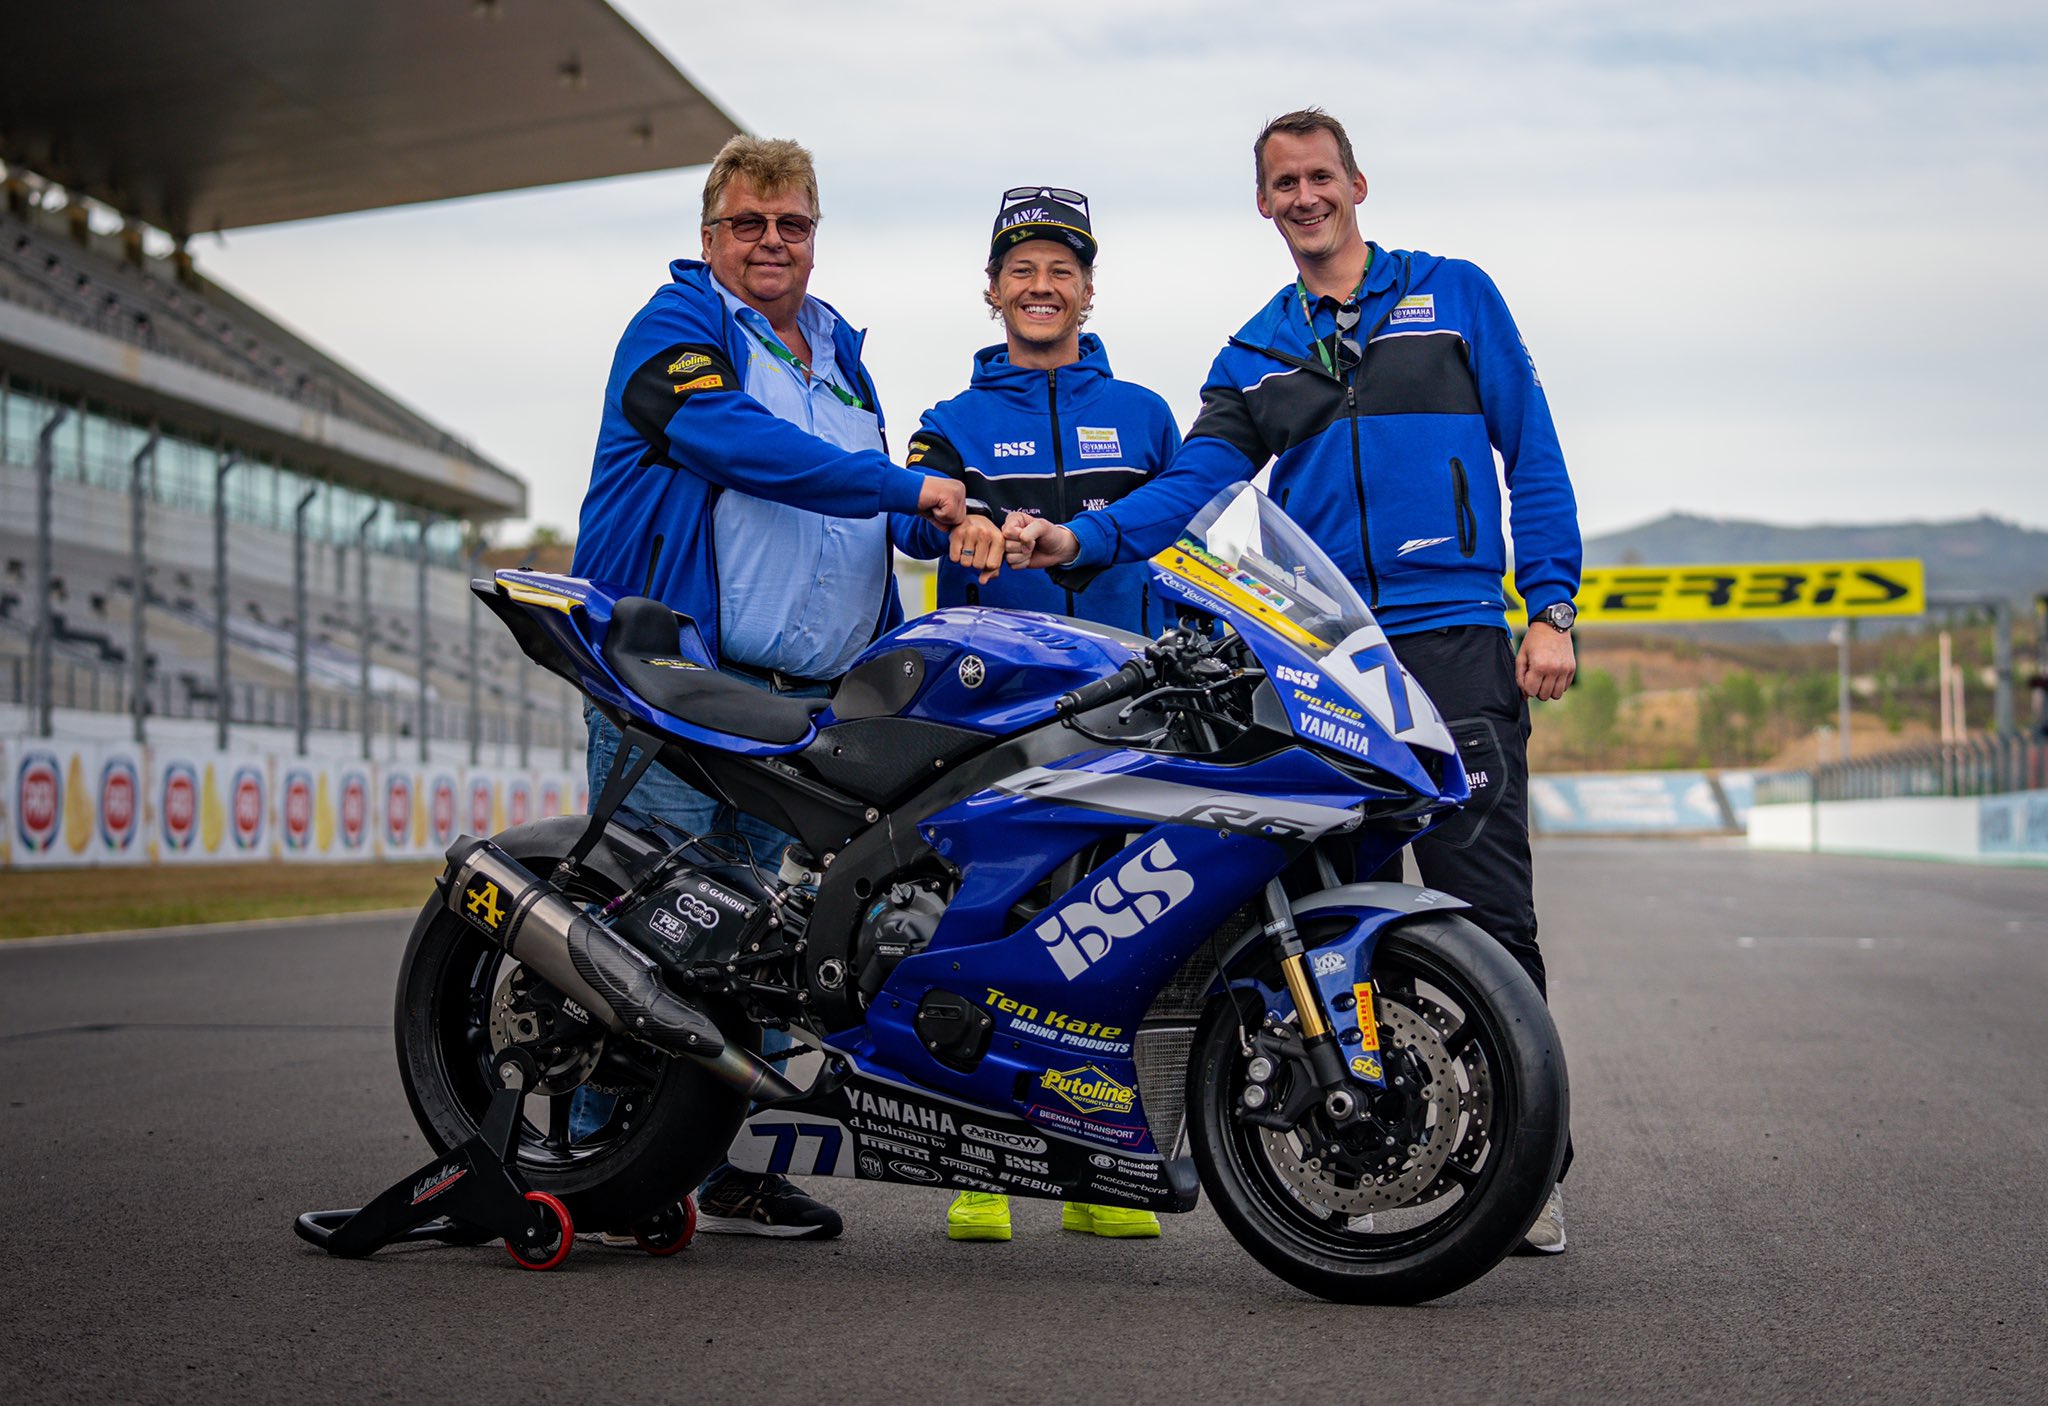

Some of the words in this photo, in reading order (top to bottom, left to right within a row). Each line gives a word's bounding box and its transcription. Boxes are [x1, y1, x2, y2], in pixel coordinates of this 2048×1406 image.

[1402, 308, 1431, 316] YAMAHA
[668, 355, 712, 375] Putoline
[1090, 442, 1117, 450] YAMAHA
[1153, 571, 1188, 593] Revs
[1182, 586, 1209, 606] Your
[1205, 599, 1232, 616] Heart
[1350, 643, 1415, 735] 7
[1293, 688, 1322, 706] Ten
[1324, 701, 1362, 720] Kate
[1307, 703, 1332, 716] RACING
[1332, 712, 1366, 729] PRODUCTS
[1300, 711, 1369, 756] YAMAHA
[658, 913, 680, 931] PB
[683, 900, 712, 921] REGINA
[652, 921, 679, 940] Pro-Bolt
[563, 997, 590, 1020] NGK
[985, 987, 1040, 1021] Ten
[1044, 1010, 1123, 1039] Kate
[1358, 990, 1377, 1047] PIRELLI
[1009, 1018, 1058, 1041] RACING
[1060, 1034, 1131, 1054] PRODUCTS
[1043, 1069, 1134, 1104] Putoline
[843, 1085, 958, 1136] YAMAHA
[1072, 1094, 1114, 1109] MOTORCYCLE
[849, 1116, 865, 1129] d.
[866, 1119, 928, 1145] holman
[931, 1138, 947, 1149] bv
[1039, 1109, 1081, 1127] BEEKMAN
[1083, 1121, 1135, 1139] TRANSPORT
[1052, 1122, 1077, 1133] LOGISTICS
[749, 1122, 844, 1176] 77
[859, 1133, 930, 1162] PIRELLI
[966, 1126, 1041, 1149] ARROW
[961, 1142, 996, 1161] ALMA
[861, 1156, 882, 1173] STM
[939, 1156, 985, 1176] SPIDER
[1117, 1158, 1159, 1171] Autoschade
[1010, 1174, 1064, 1196] FEBUR
[1090, 1182, 1150, 1204] motoholders
[1096, 1174, 1169, 1195] motocarbons
